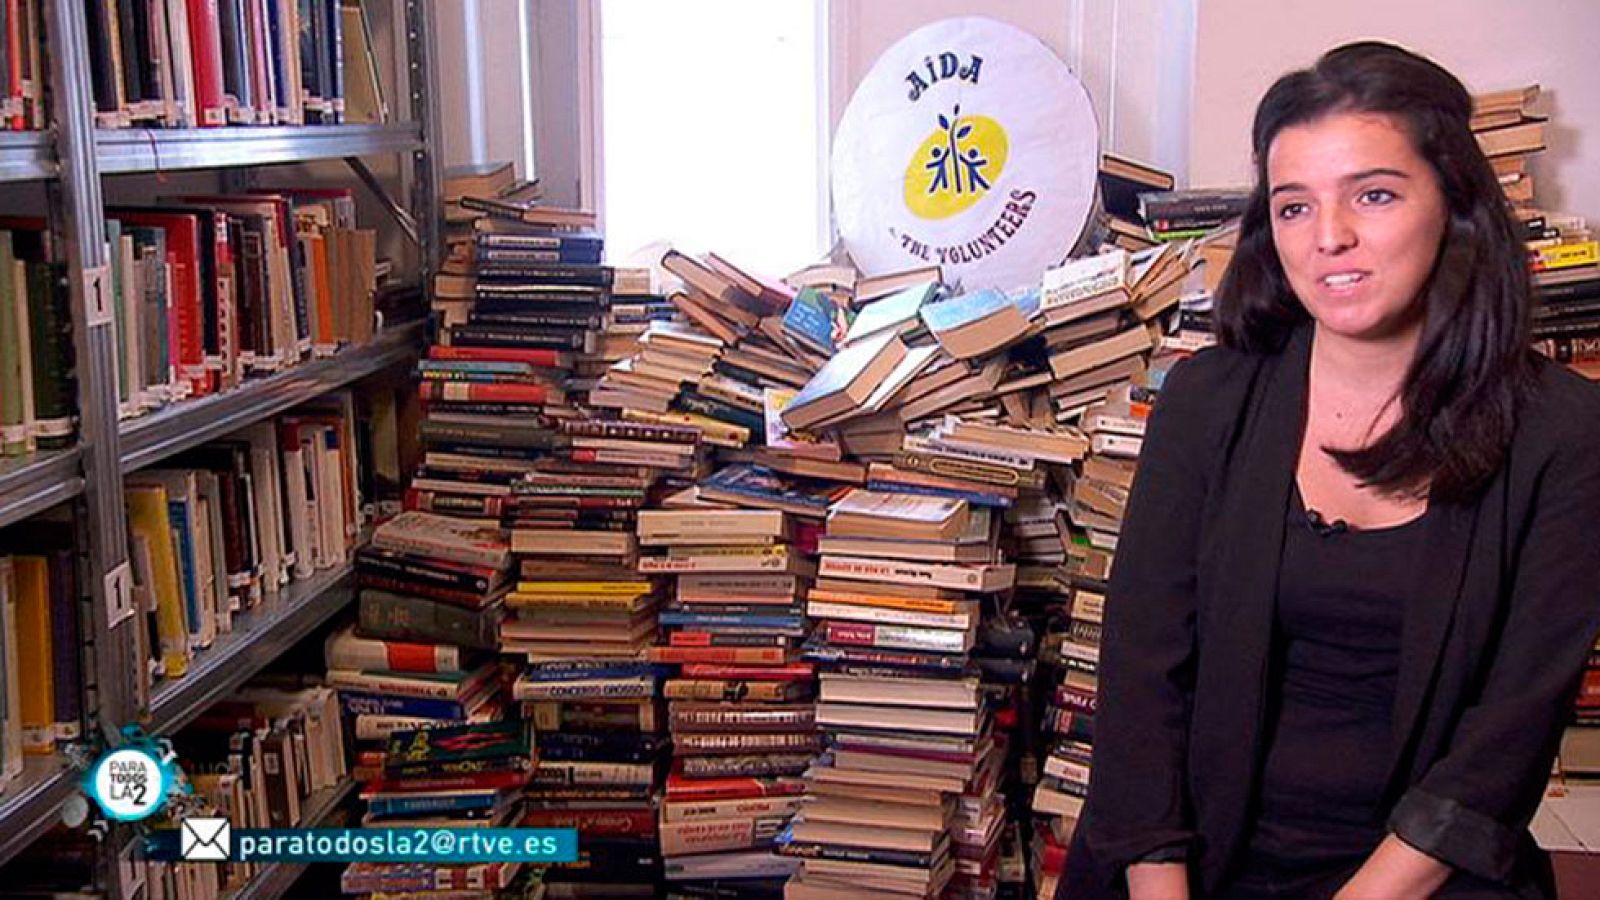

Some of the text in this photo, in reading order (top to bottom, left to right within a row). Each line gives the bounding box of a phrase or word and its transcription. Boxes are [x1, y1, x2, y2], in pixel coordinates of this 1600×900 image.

[936, 188, 1038, 265] VOLUNTEERS
[93, 277, 103, 313] 1
[113, 575, 122, 610] 1
